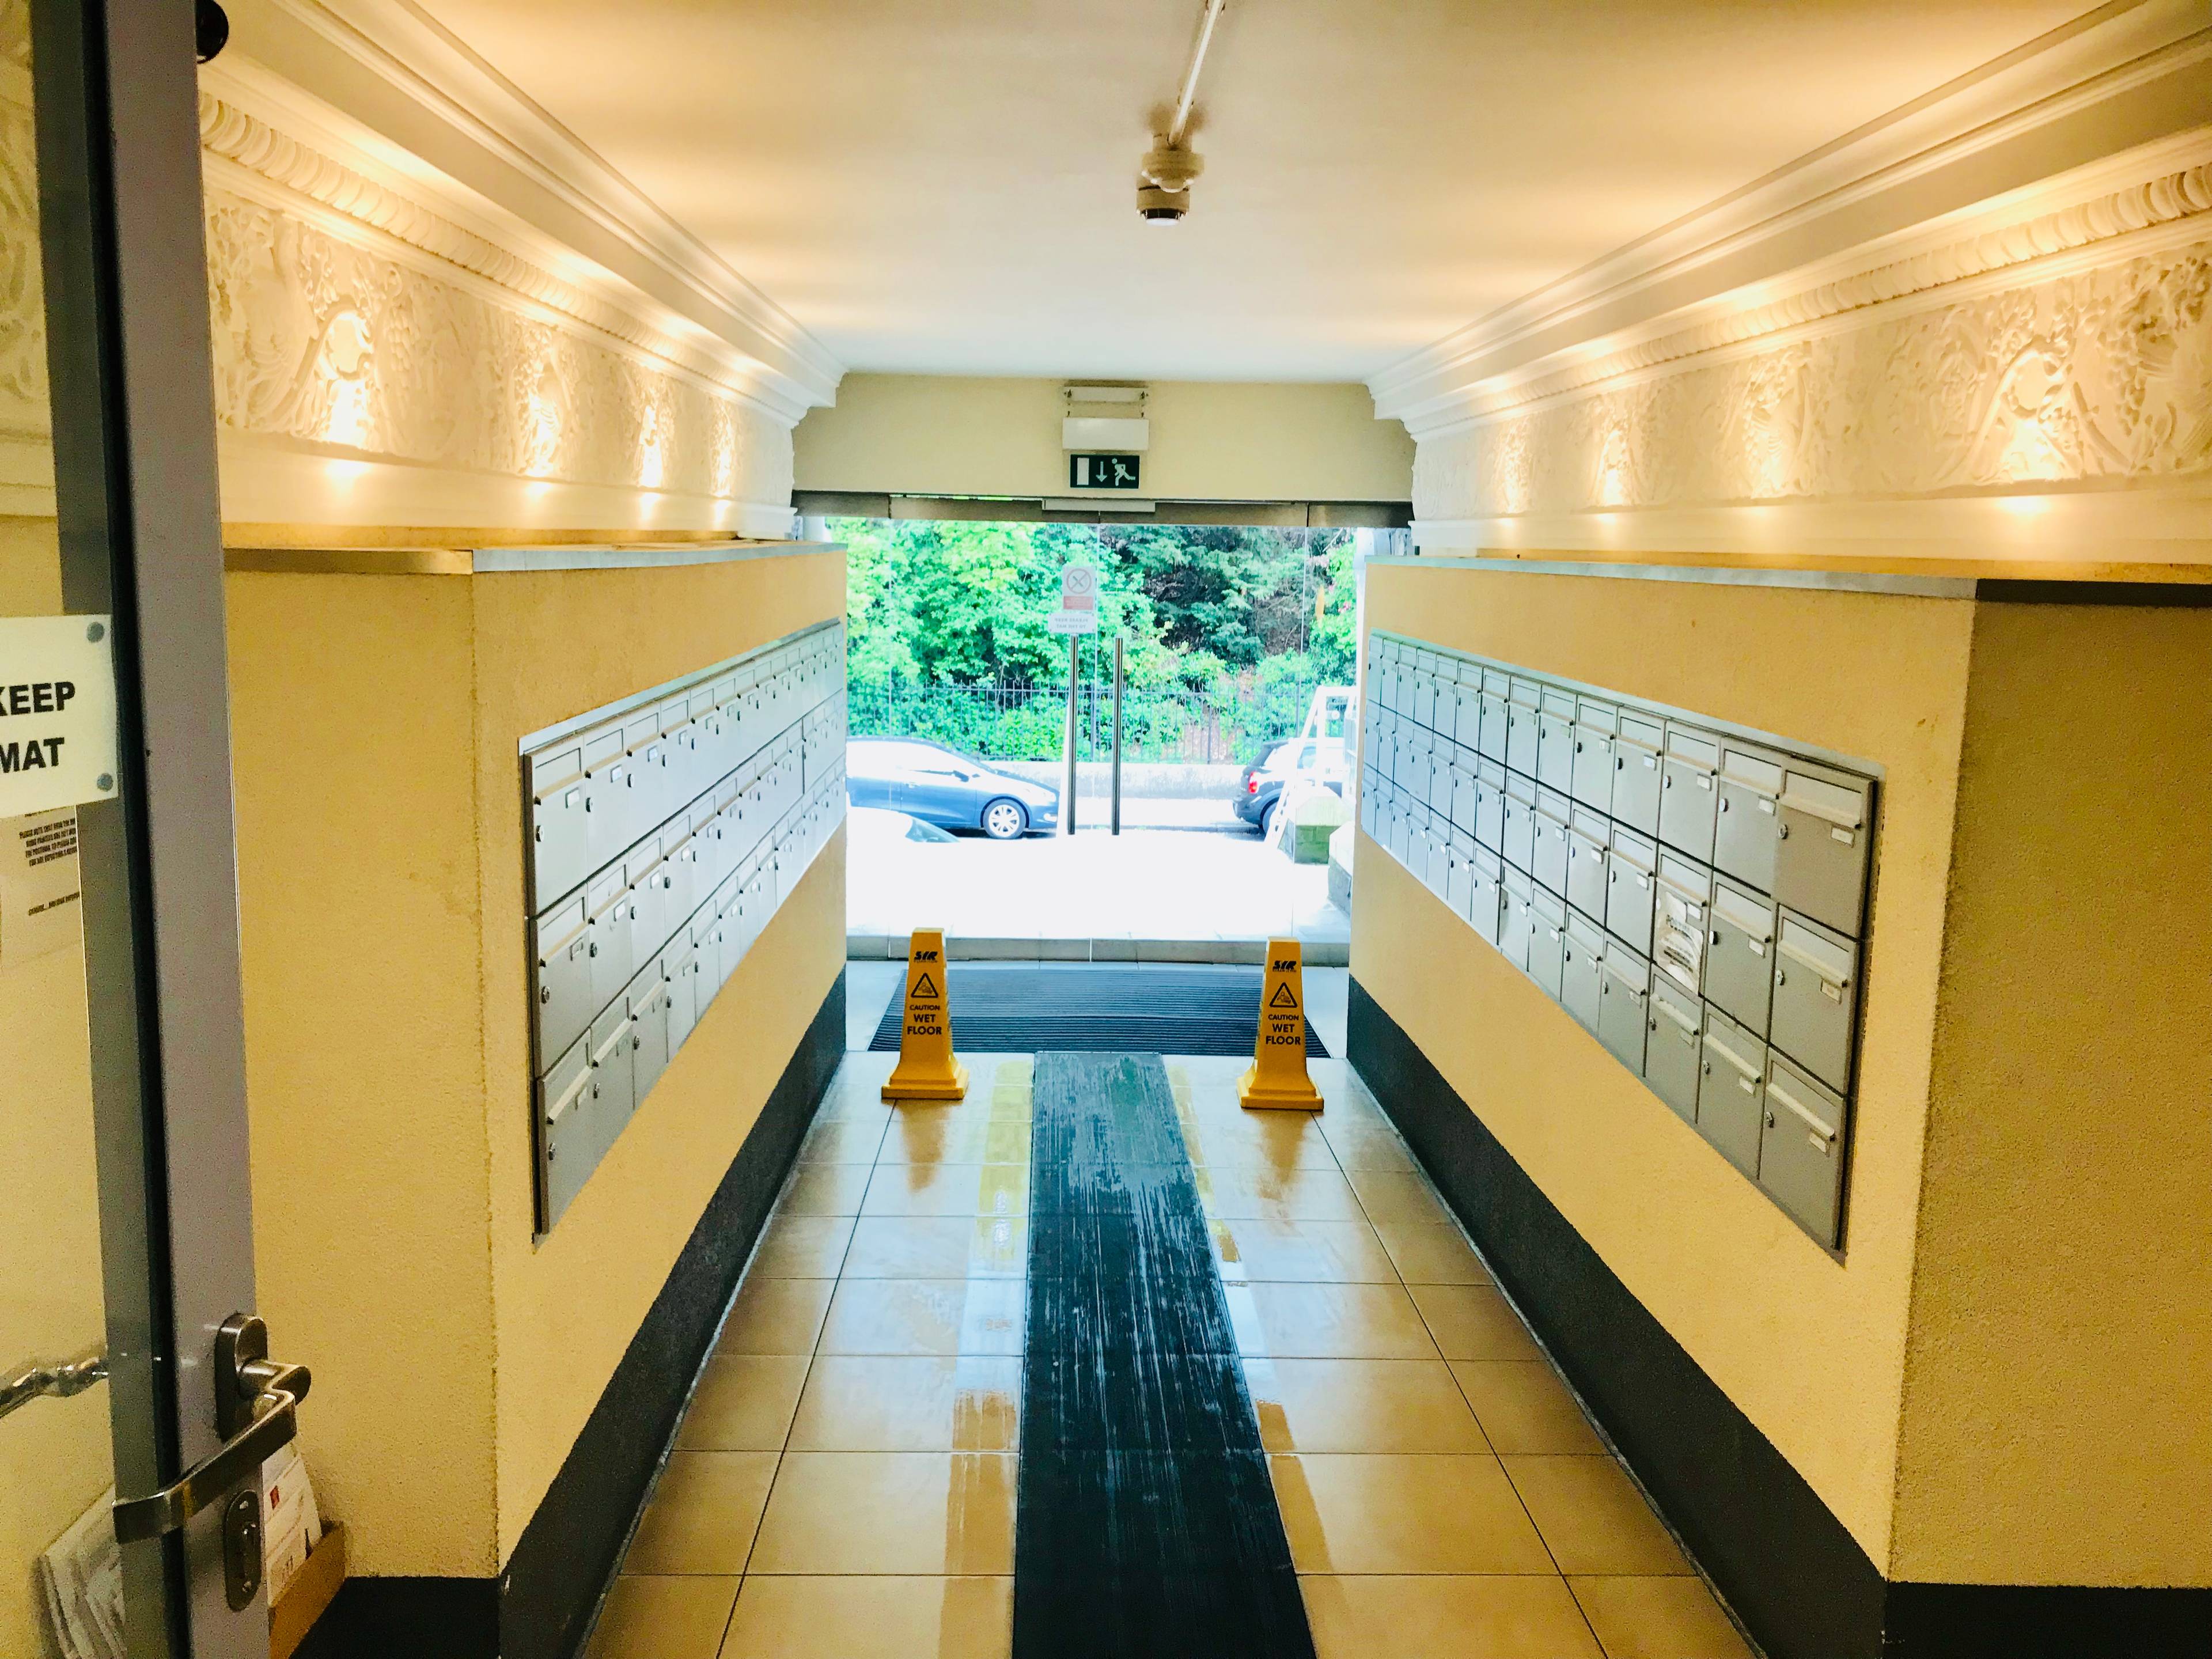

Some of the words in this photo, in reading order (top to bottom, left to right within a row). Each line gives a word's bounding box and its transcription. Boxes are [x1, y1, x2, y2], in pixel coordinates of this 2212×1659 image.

[0, 737, 65, 773] MAT
[914, 951, 938, 960] SIR
[1272, 960, 1297, 969] SIR
[914, 1014, 936, 1023] WET
[907, 1026, 942, 1035] FLOOR
[1272, 1024, 1295, 1033] WET
[1266, 1036, 1301, 1045] FLOOR
